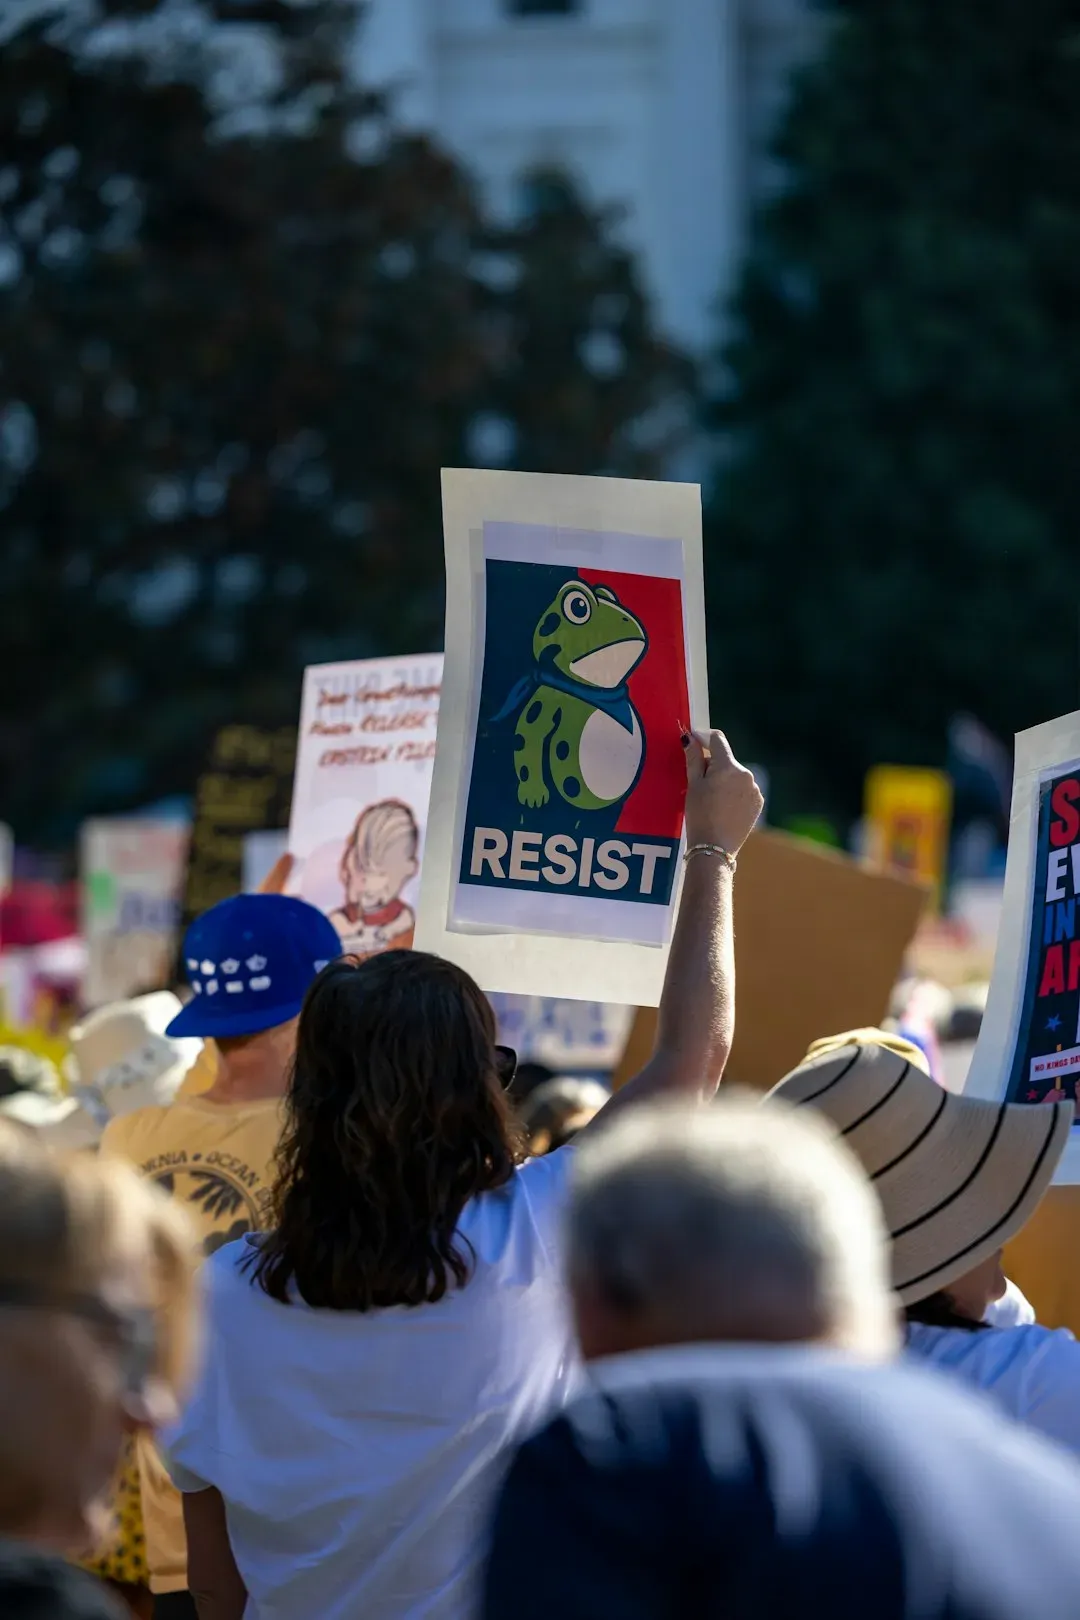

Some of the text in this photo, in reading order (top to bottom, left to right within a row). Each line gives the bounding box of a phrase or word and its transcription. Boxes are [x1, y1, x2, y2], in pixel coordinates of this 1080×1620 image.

[469, 826, 672, 895] RESIST
[1034, 1063, 1045, 1072] NO
[1046, 1058, 1068, 1071] KINGS
[205, 1150, 260, 1189] OCEAN
